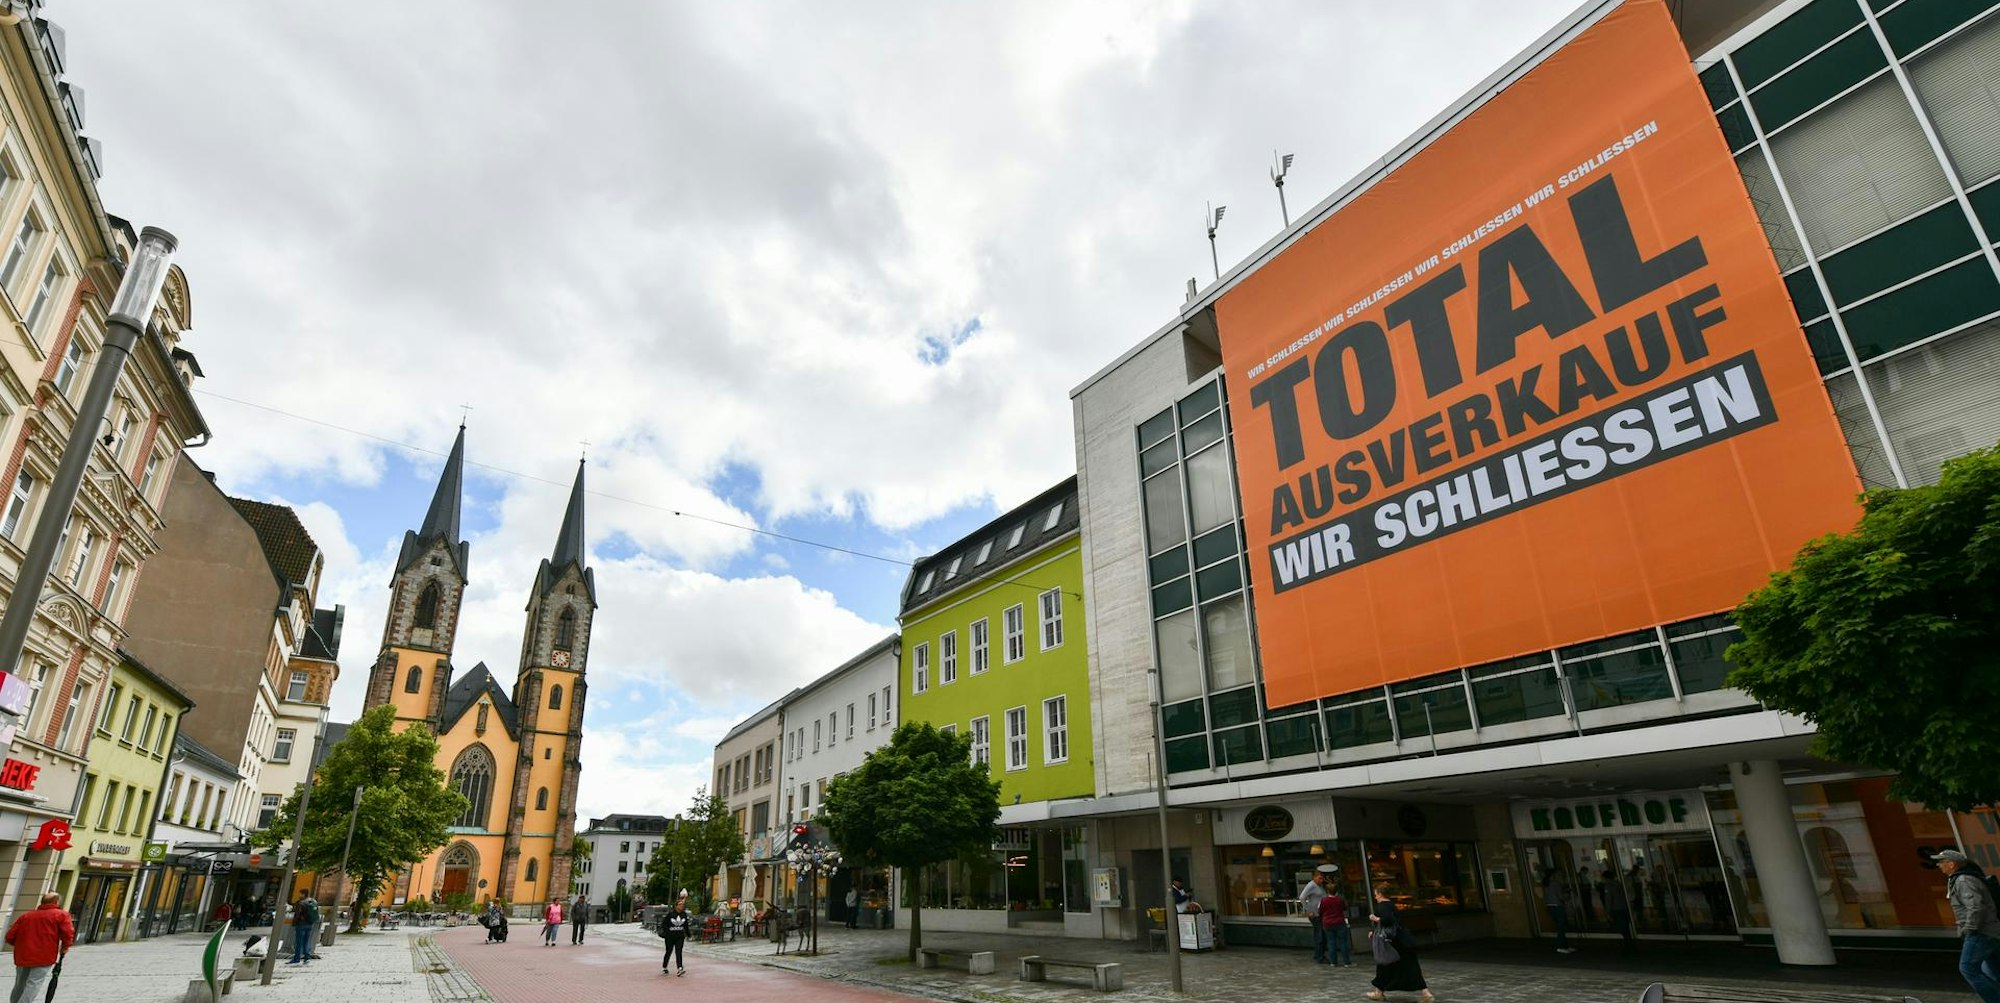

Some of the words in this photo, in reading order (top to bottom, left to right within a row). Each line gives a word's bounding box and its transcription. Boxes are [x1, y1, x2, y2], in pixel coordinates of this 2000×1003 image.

[1247, 362, 1266, 380] WIR
[1266, 327, 1323, 369] SCHLIESSEN
[1323, 312, 1345, 332] WIR
[1346, 272, 1414, 319] SCHLIESSEN
[1414, 254, 1440, 277] WIR
[1442, 203, 1523, 260] SCHLIESSEN
[1524, 184, 1556, 209] WIR
[1557, 120, 1658, 189] SCHLIESSEN
[1249, 172, 1709, 472] TOTAL
[1269, 282, 1728, 537] AUSVERKAUF
[1272, 522, 1356, 586] WIR
[1374, 363, 1761, 550] SCHLIESSEN
